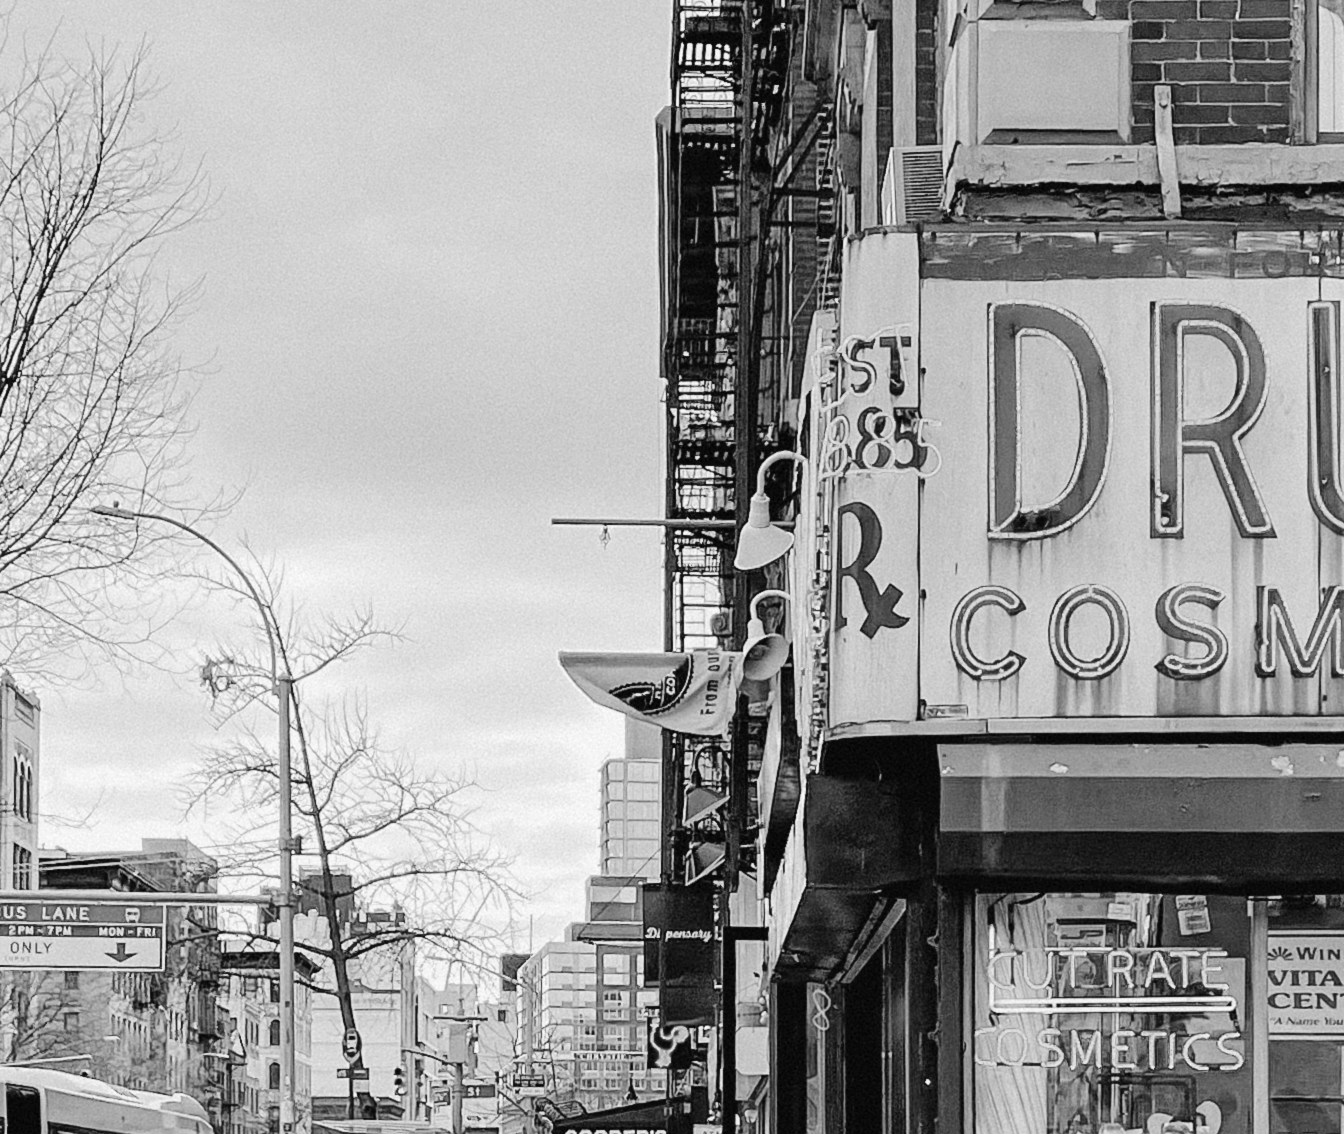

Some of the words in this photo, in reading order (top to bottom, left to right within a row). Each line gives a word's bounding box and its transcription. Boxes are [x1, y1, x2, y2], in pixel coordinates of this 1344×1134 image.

[42, 907, 90, 921] LANE
[8, 925, 35, 937] 2PM
[47, 926, 73, 937] 7PM
[98, 927, 124, 938] MON
[136, 928, 157, 938] FRI
[10, 941, 53, 955] ONLY
[988, 950, 1088, 990] CUT
[1107, 950, 1230, 990] RATE
[1285, 1016, 1320, 1026] Name
[1324, 1016, 1344, 1026] You
[974, 1026, 1245, 1071] COSMETICS
